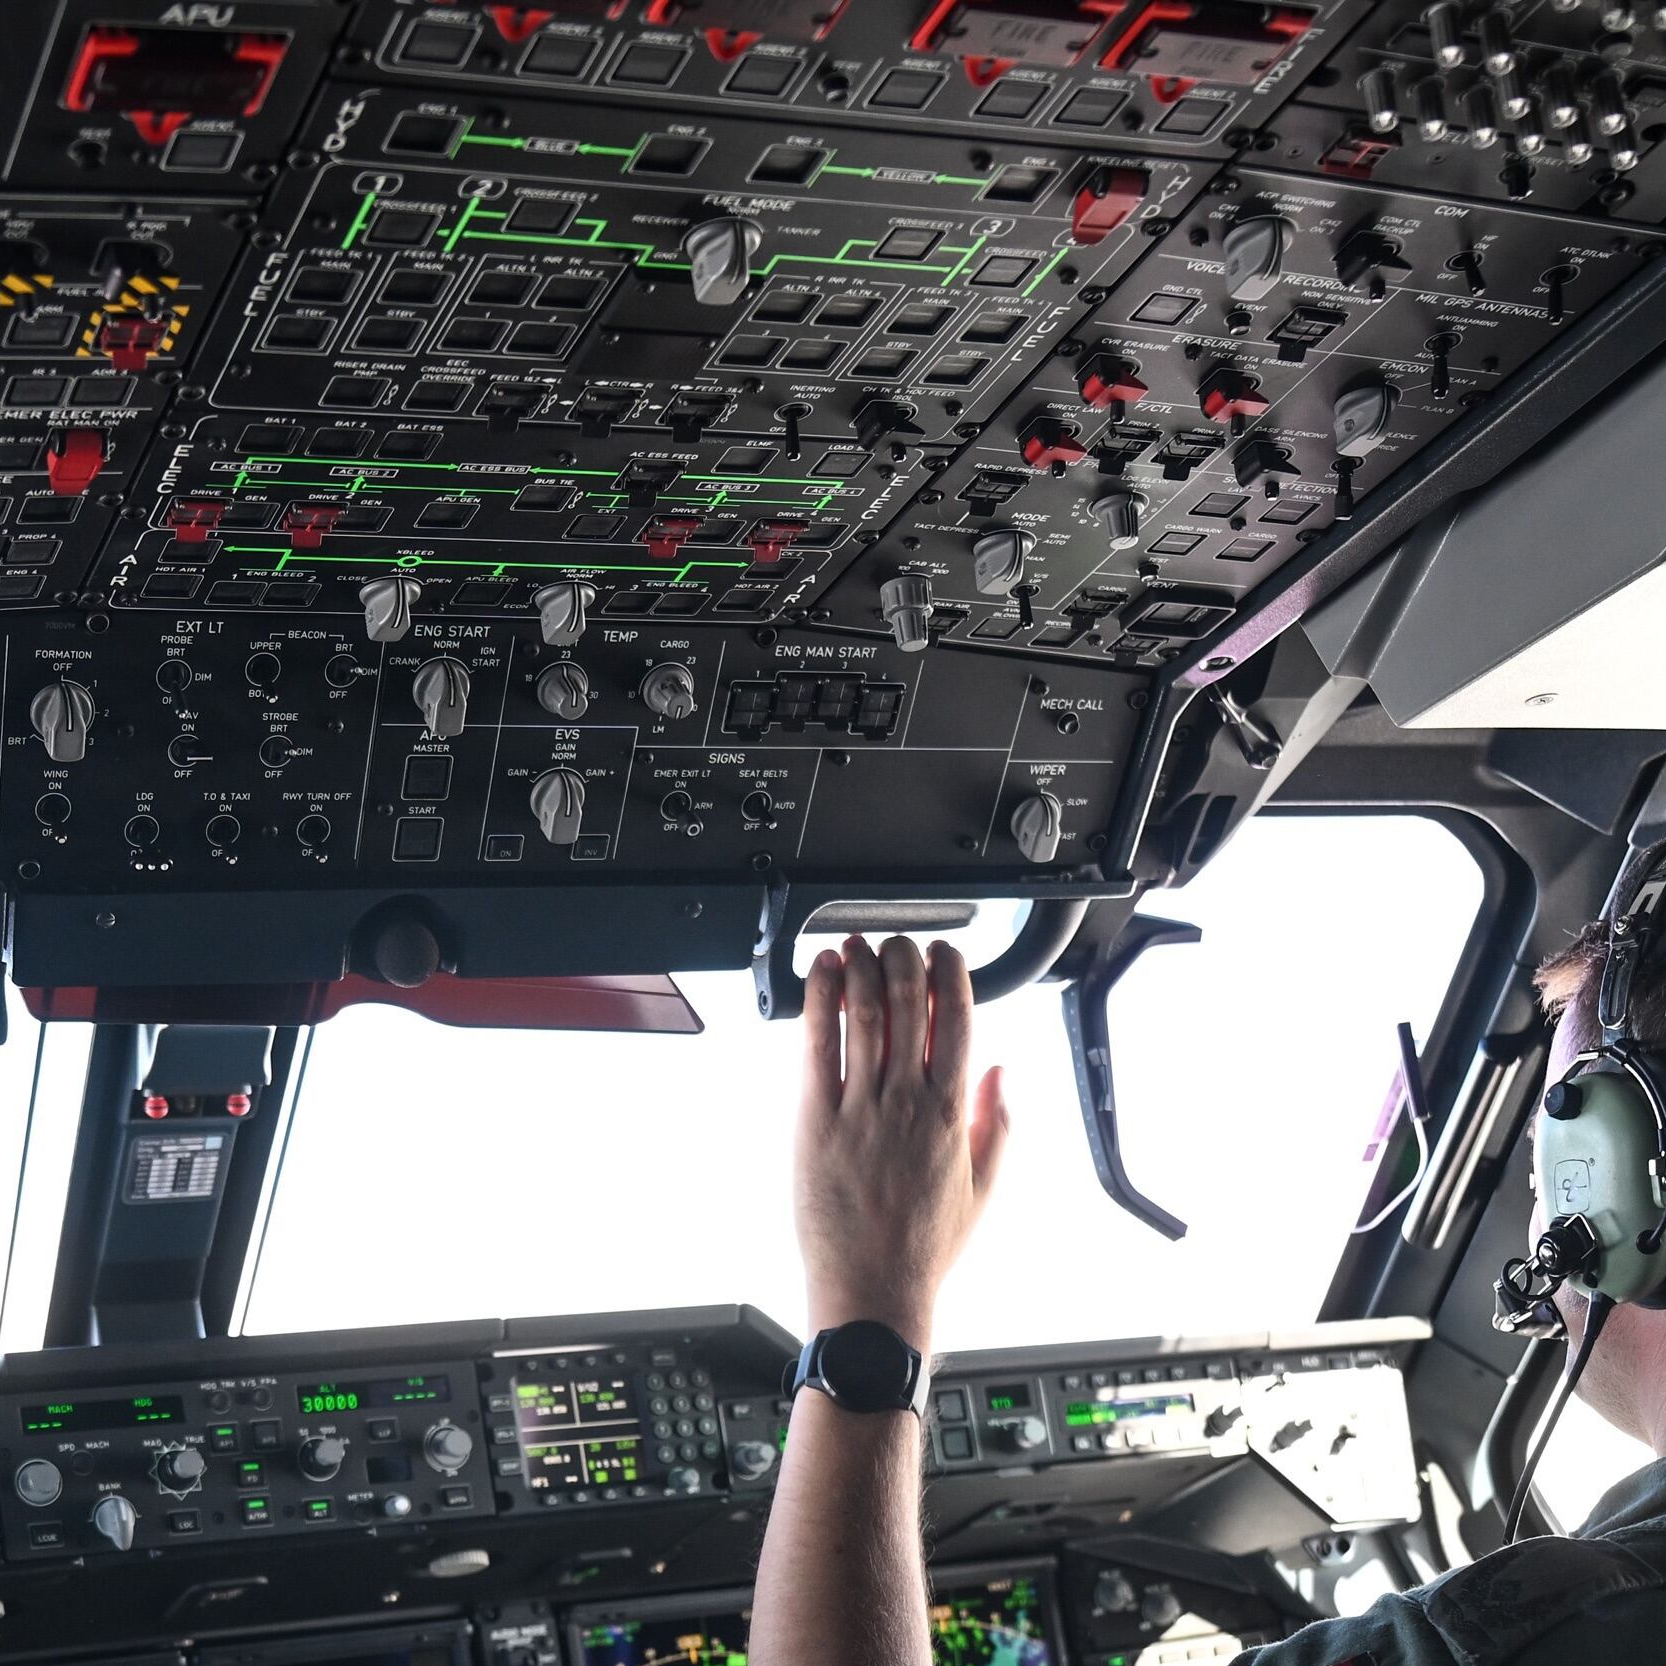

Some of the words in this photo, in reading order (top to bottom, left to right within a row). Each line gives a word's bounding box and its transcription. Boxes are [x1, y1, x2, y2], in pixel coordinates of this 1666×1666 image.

[159, 2, 232, 26] APU
[1433, 205, 1469, 219] COM
[1186, 261, 1226, 275] VOICE
[1414, 293, 1439, 306] MIL
[1444, 297, 1477, 311] GPS
[1478, 301, 1550, 319] ANTENNAS
[1010, 306, 1064, 362] FUEL
[1171, 334, 1241, 351] ERASURE
[333, 361, 367, 370] RISER
[371, 363, 406, 372] DRAIN
[420, 366, 486, 376] CROSSFEED
[1378, 360, 1429, 374] EMCON
[421, 374, 476, 383] OVERRIDE
[1046, 402, 1079, 413] DIRECT
[1081, 405, 1105, 416] LAW
[1135, 402, 1173, 414] F/CTL
[50, 411, 93, 420] ELEC
[98, 411, 138, 420] PWR
[156, 444, 194, 495] ELEC
[974, 463, 1006, 472] RAPID
[1009, 467, 1049, 477] DEPRESS
[1011, 511, 1051, 523] MODE
[109, 554, 138, 587] AIR
[176, 621, 201, 632] EXT
[206, 623, 223, 633] LT
[414, 624, 443, 638] ENG
[448, 625, 491, 638] START
[161, 635, 193, 645] PROBE
[288, 630, 327, 640] BEACON
[603, 630, 638, 642] TEMP
[250, 641, 282, 650] UPPER
[433, 640, 460, 649] NORM
[660, 640, 690, 649] CARGO
[35, 650, 92, 660] FORMATION
[480, 646, 496, 655] IGN
[775, 645, 799, 657] ENG
[804, 646, 831, 658] MAN
[835, 647, 877, 659] START
[53, 662, 72, 671] OFF
[389, 657, 420, 666] CRANK
[472, 658, 501, 667] START
[195, 672, 212, 682] DIM
[1040, 699, 1070, 710] MECH
[1075, 700, 1104, 711] CALL
[262, 712, 298, 721] STROBE
[555, 729, 580, 740] EVS
[413, 744, 450, 753] MASTER
[555, 743, 576, 751] GAIN
[708, 753, 746, 765] SIGNS
[42, 769, 69, 779] WING
[654, 770, 677, 778] EMER
[681, 770, 698, 778] EXIT
[701, 770, 711, 778] LT
[739, 770, 761, 778] SEAT
[763, 770, 788, 778] BELTS
[1030, 765, 1065, 776] WIPER
[48, 781, 62, 790] ON
[136, 792, 154, 801] LDG
[283, 792, 304, 801] RWY
[309, 792, 332, 801] TURN
[335, 792, 352, 801] OFF
[408, 806, 437, 815] START
[695, 802, 713, 810] ARM
[774, 802, 795, 810] AUTO
[48, 1403, 74, 1414] MACH
[302, 1395, 358, 1413] 30000
[98, 1482, 122, 1491] BANK
